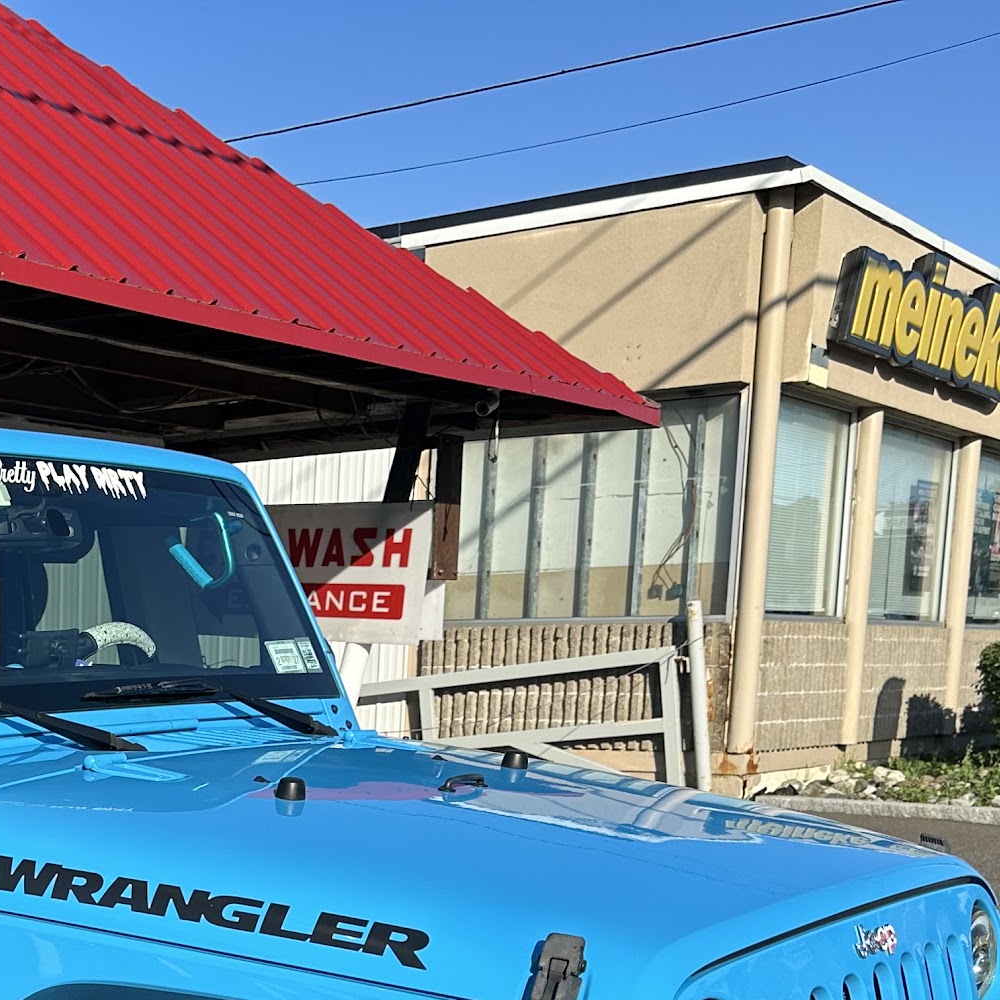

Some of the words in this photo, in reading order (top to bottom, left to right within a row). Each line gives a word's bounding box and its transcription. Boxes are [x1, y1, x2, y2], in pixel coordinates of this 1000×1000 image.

[851, 257, 1000, 393] meinek
[36, 460, 90, 495] PLAY
[90, 465, 148, 501] DIRTY
[287, 527, 413, 568] WASH
